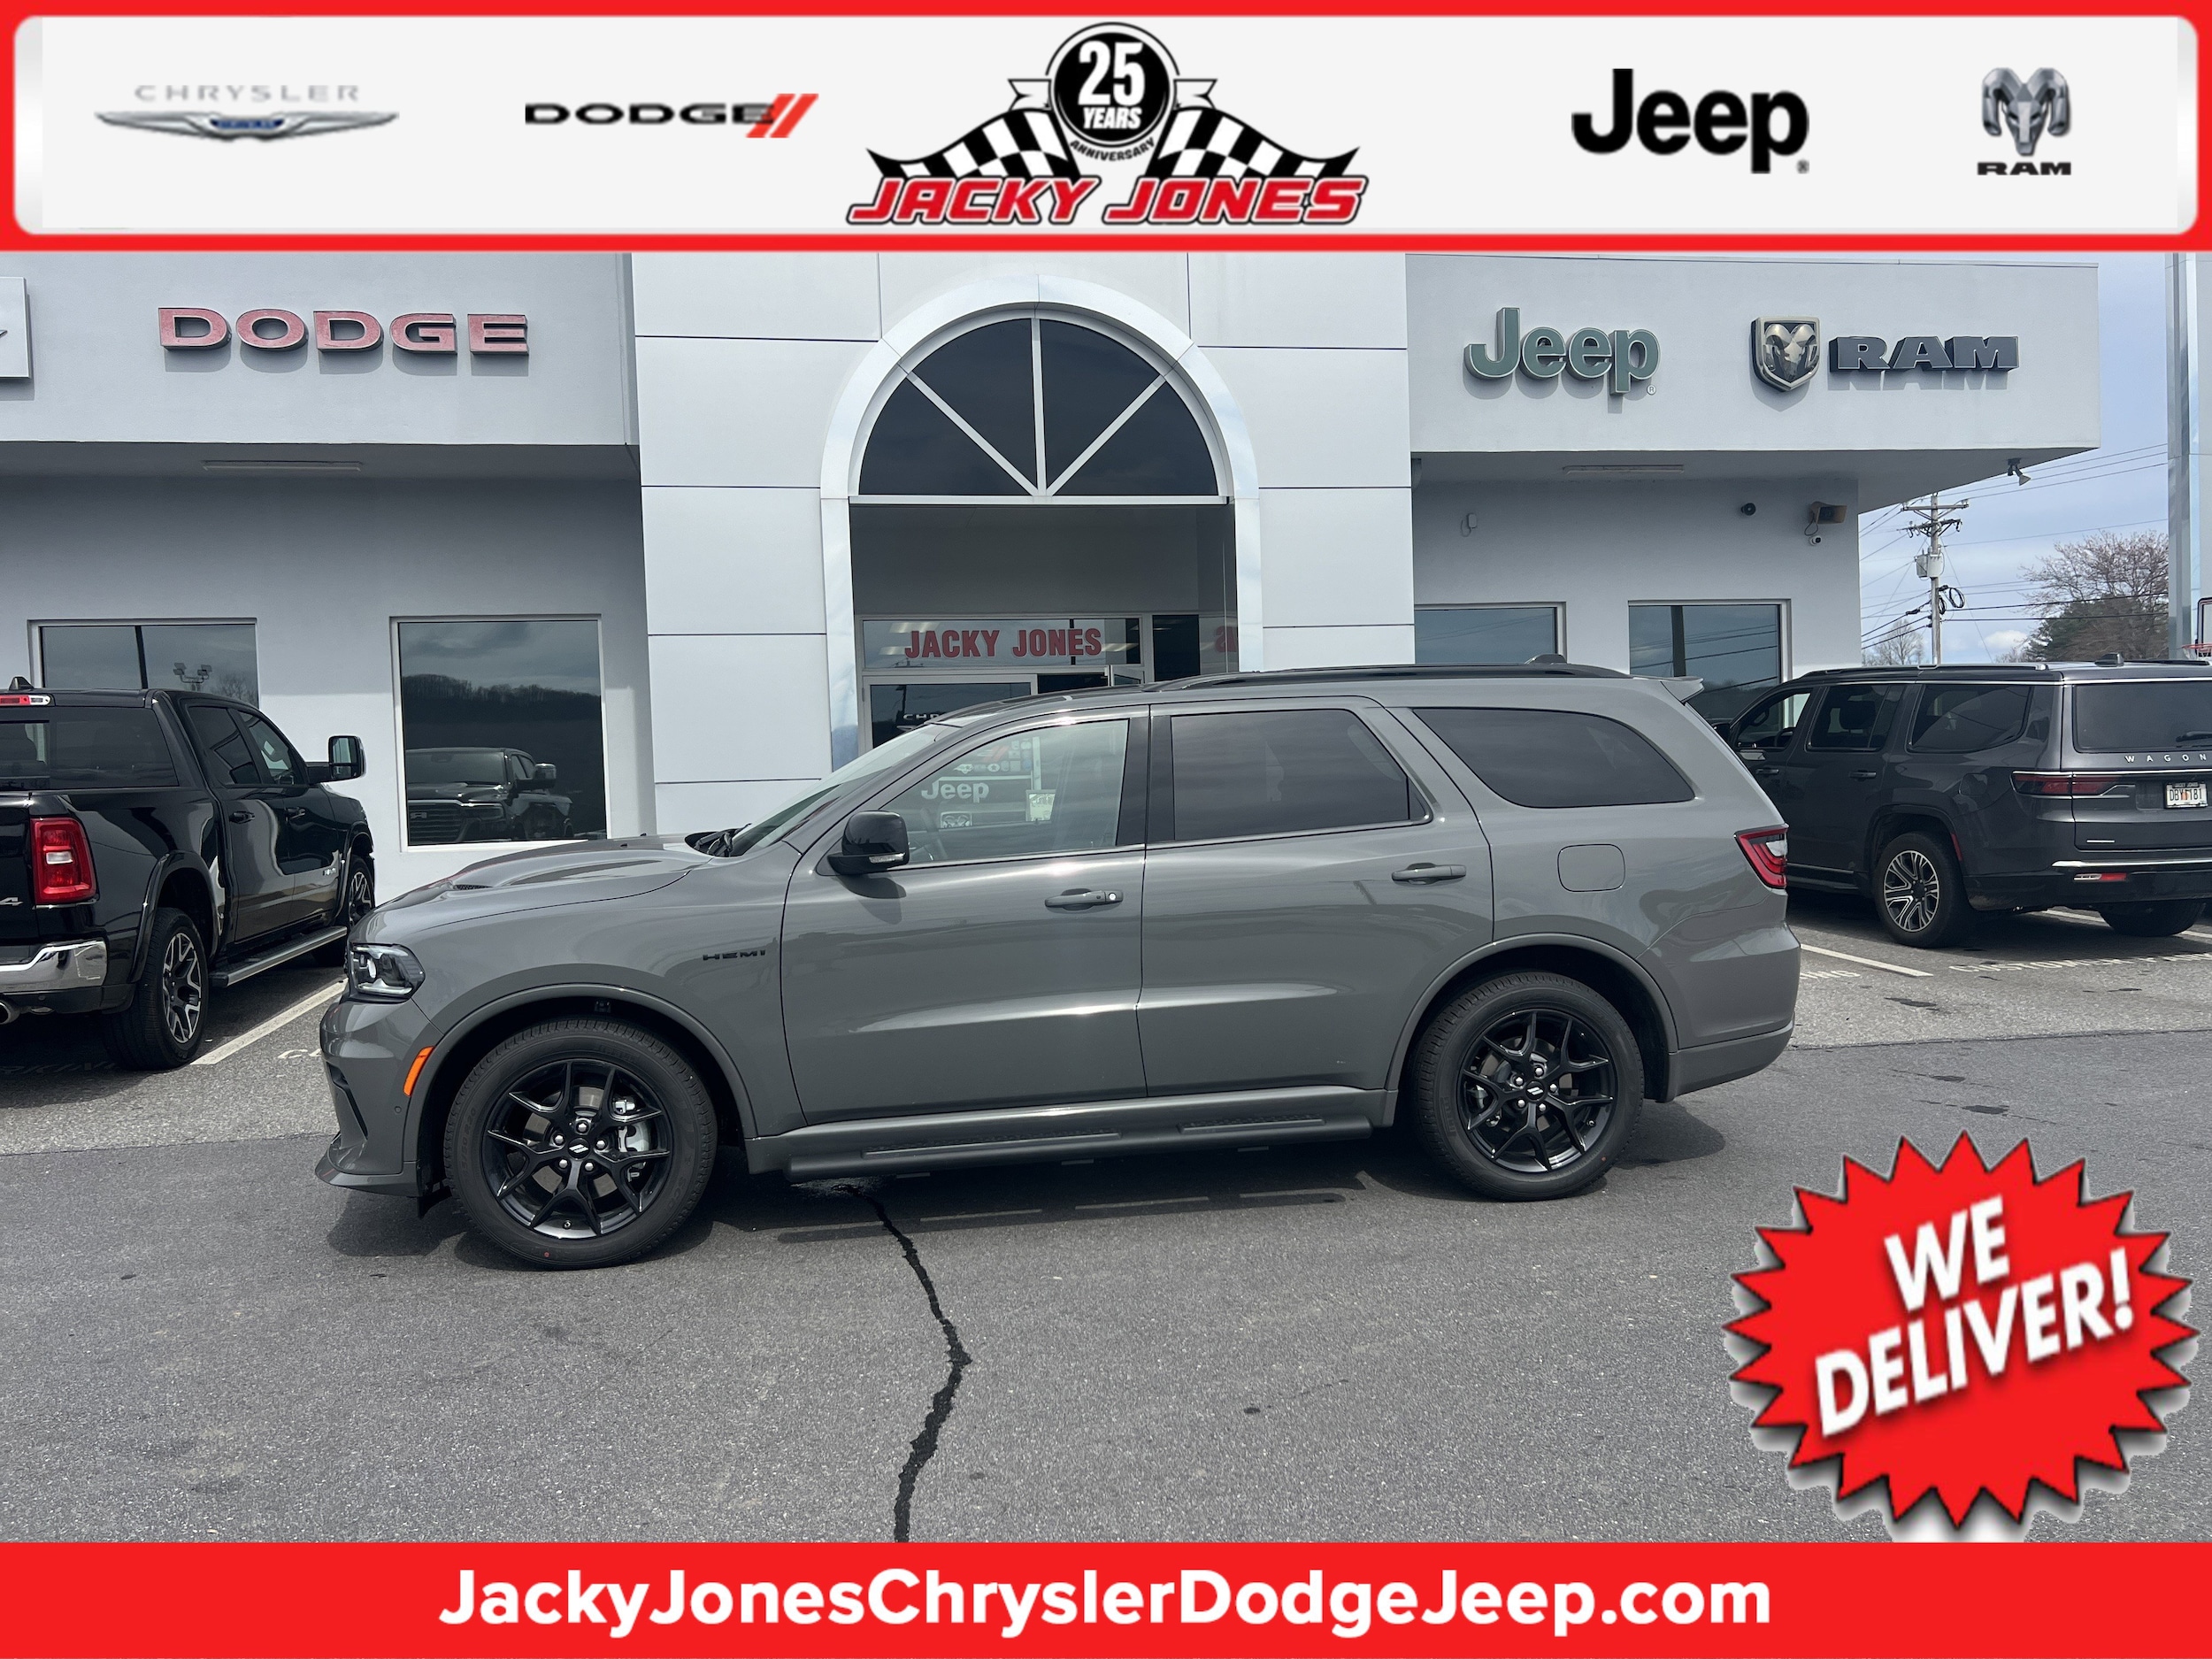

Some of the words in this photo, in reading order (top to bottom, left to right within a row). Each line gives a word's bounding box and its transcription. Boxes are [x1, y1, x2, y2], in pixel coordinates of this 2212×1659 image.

[158, 307, 529, 354] DODGE
[1464, 307, 1660, 396] Jeep
[1829, 335, 2020, 373] RAM
[903, 629, 1000, 659] JACKY
[1012, 627, 1102, 657] JONES
[2124, 753, 2207, 763] WAGON
[921, 780, 989, 803] Jeep
[703, 949, 766, 961] HEMI
